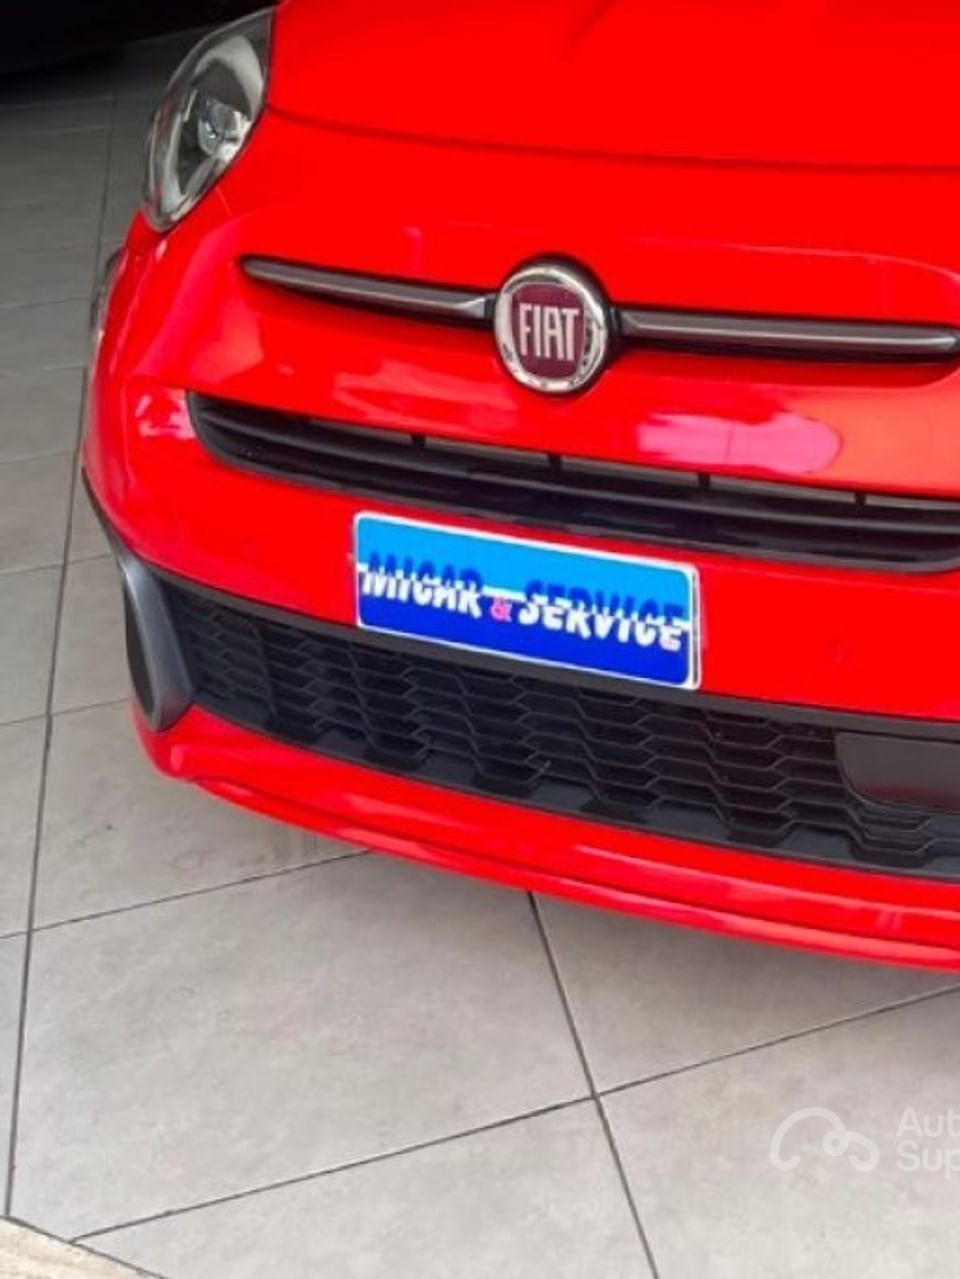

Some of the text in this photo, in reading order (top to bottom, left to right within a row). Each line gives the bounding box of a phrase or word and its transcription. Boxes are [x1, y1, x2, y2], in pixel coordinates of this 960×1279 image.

[519, 303, 578, 361] FIAT
[362, 552, 684, 652] MICAR & SERVICE
